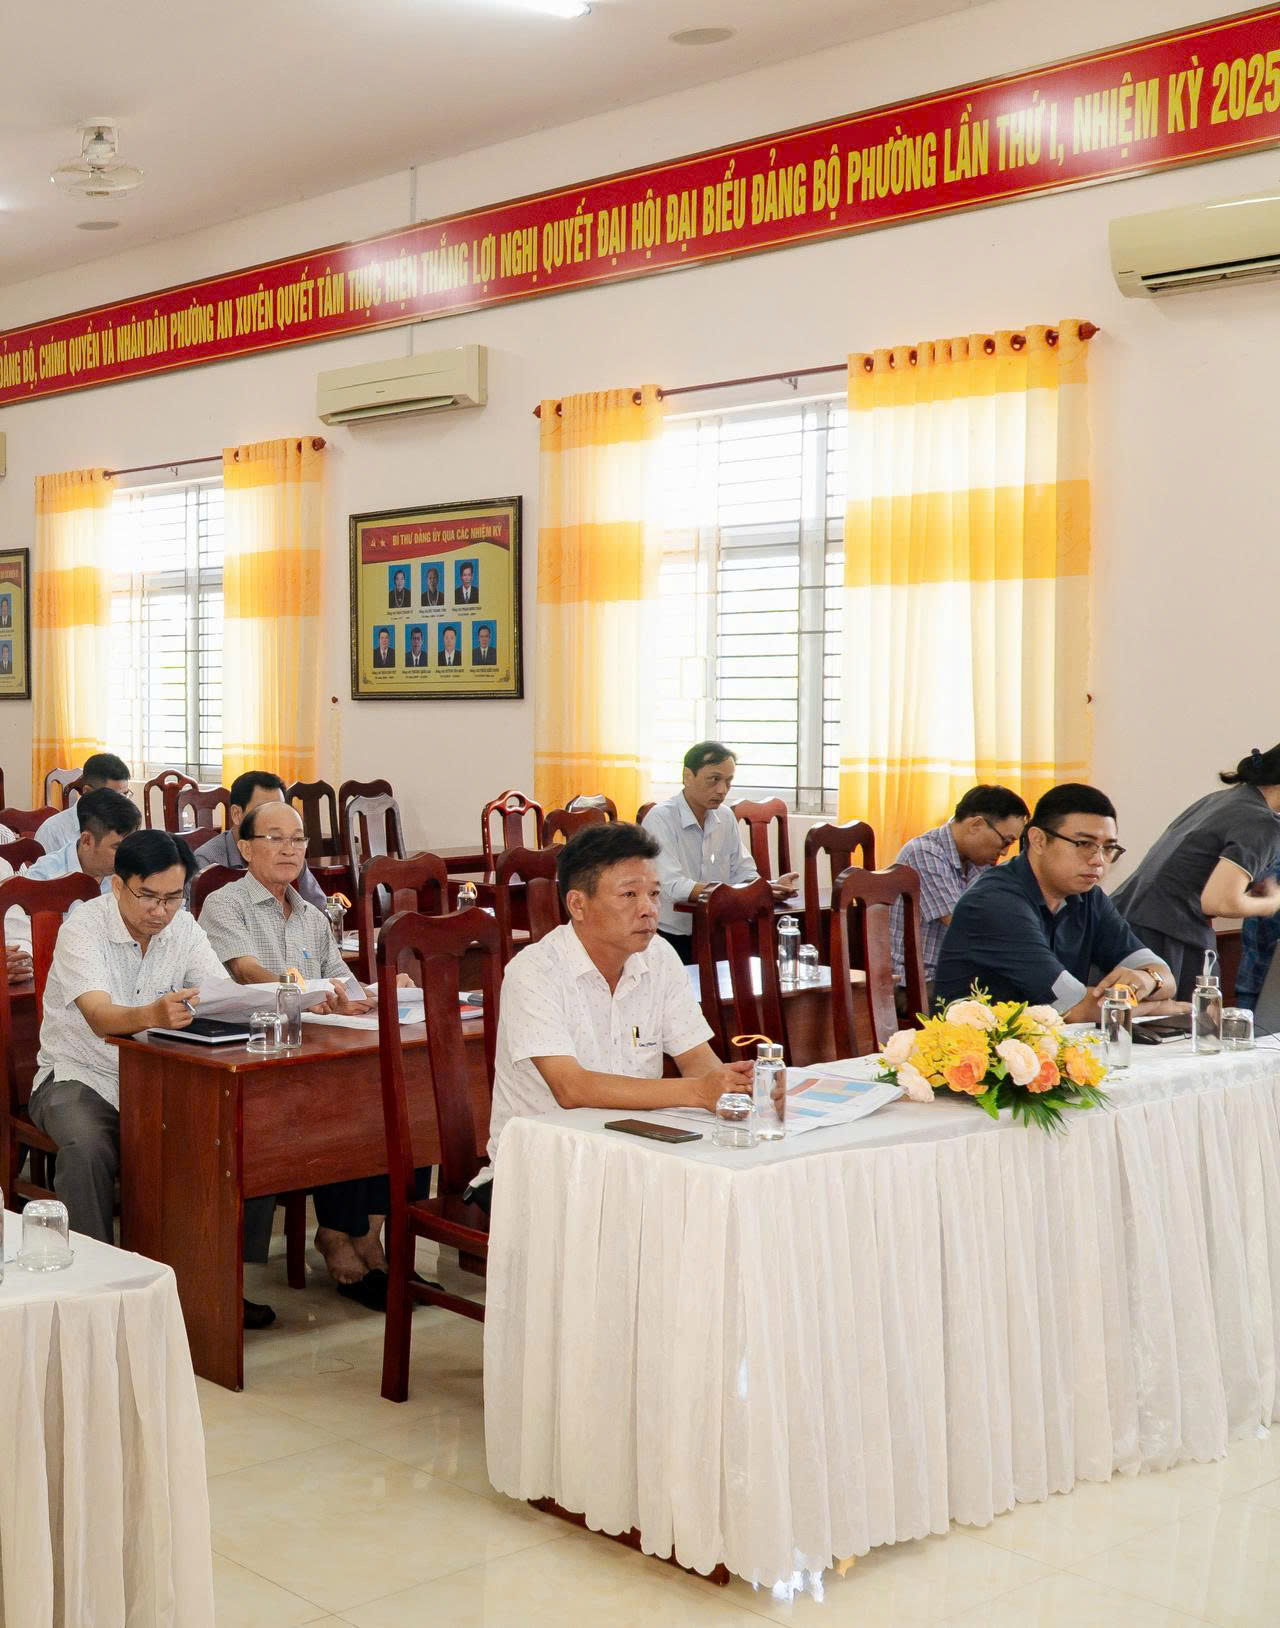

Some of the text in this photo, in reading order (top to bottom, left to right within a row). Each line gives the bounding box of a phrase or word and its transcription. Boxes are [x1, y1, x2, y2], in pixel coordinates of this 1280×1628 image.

[23, 342, 37, 388] BỘ,
[39, 335, 67, 379] CHÍNH
[69, 320, 99, 372] QUYỀN
[101, 321, 115, 363] VÀ
[117, 310, 145, 361] NHÂN
[146, 311, 168, 353] DÂN
[170, 297, 214, 349] PHƯỜNG
[216, 304, 232, 340] AN
[235, 286, 274, 335] XUYÊN
[276, 266, 314, 330] QUYẾT
[317, 266, 344, 318] TÂM
[348, 261, 381, 316] THỰC
[385, 248, 418, 308] HIỆN
[421, 231, 469, 294] THẮNG
[473, 239, 496, 292] LỢI
[500, 227, 538, 282] NGHỊ
[542, 198, 593, 272] QUYẾT
[597, 204, 626, 265] ĐẠI
[631, 190, 662, 258] HỘI
[666, 189, 697, 252] ĐẠI
[702, 159, 746, 235] BIỂU
[751, 148, 806, 226] ĐẢNG
[813, 144, 840, 220] BỘ
[847, 125, 936, 204] PHƯỜNG
[943, 104, 989, 181] LẦN
[996, 90, 1046, 171] THỨ
[1073, 72, 1160, 158] NHIỆM
[1167, 55, 1204, 134] KỲ
[1210, 49, 1280, 125] 2025
[442, 530, 455, 543] QUA
